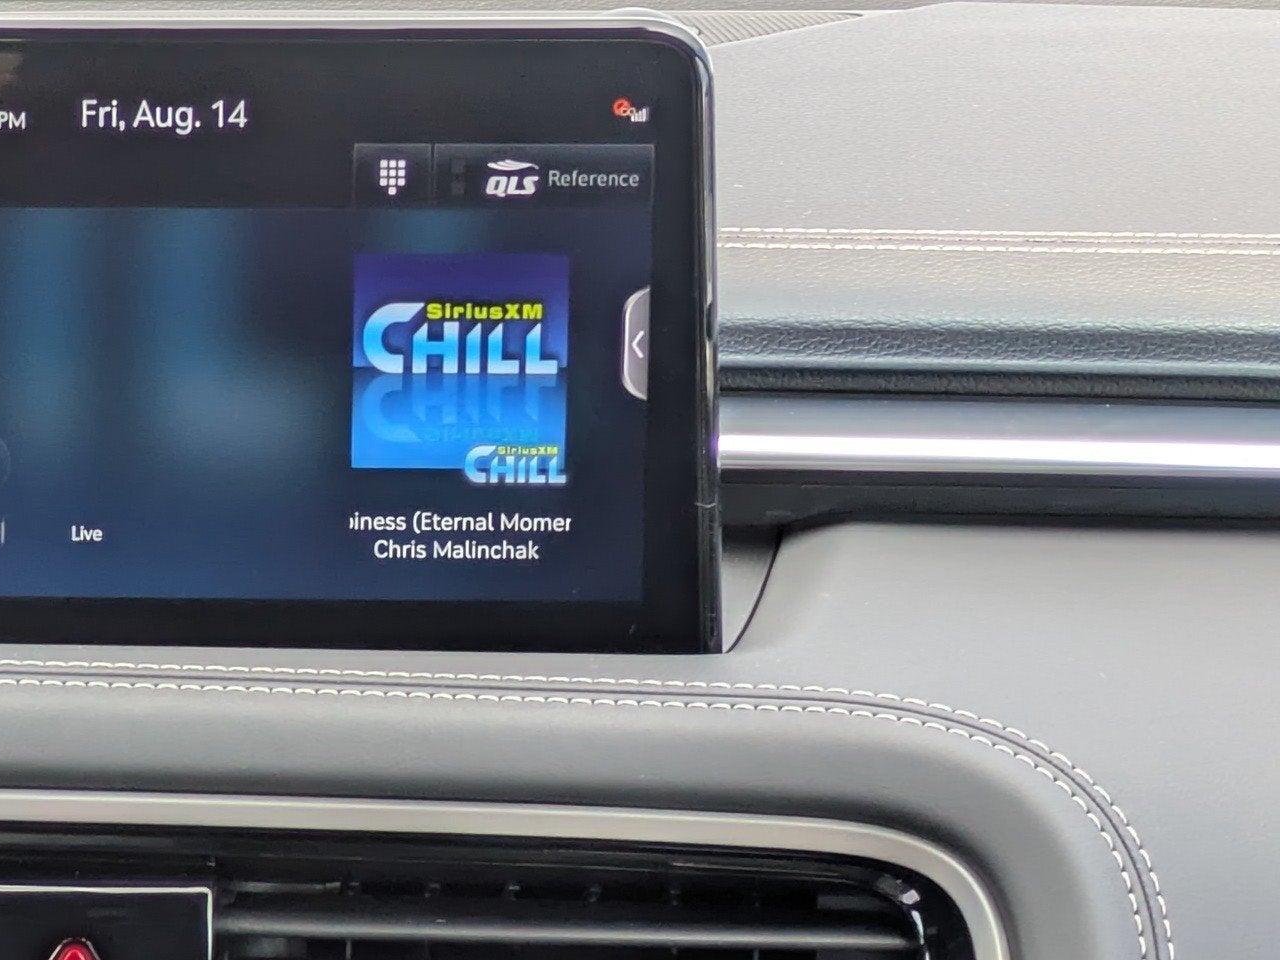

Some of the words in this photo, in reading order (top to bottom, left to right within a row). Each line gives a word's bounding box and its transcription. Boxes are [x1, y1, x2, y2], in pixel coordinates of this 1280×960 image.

[81, 99, 125, 131] Fri,
[133, 100, 201, 135] Aug.
[212, 100, 248, 128] 14
[485, 175, 539, 196] QLS
[548, 169, 640, 188] Reference
[426, 303, 544, 320] SiriusXM
[412, 511, 495, 533] (Eternal
[71, 525, 103, 542] Live
[373, 539, 428, 559] Chris
[433, 540, 540, 560] Malinchak
